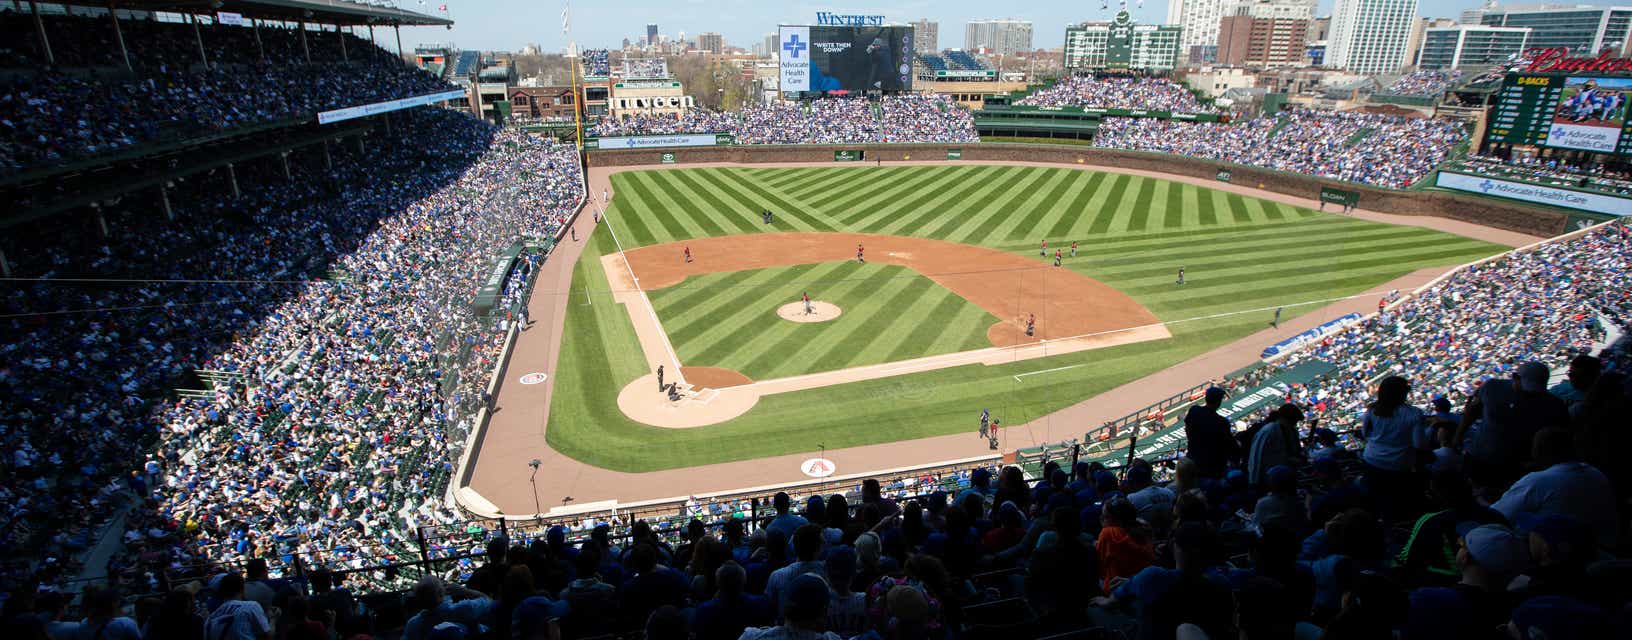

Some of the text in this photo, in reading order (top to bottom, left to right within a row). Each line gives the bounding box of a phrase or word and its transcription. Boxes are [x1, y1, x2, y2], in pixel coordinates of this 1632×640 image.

[816, 12, 885, 26] WINTRUST
[1518, 77, 1549, 85] D-BACKS
[609, 96, 695, 109] nuveen
[1567, 130, 1607, 140] Advocate
[1563, 139, 1614, 149] Health Care
[1495, 184, 1588, 204] Advocate Health Care
